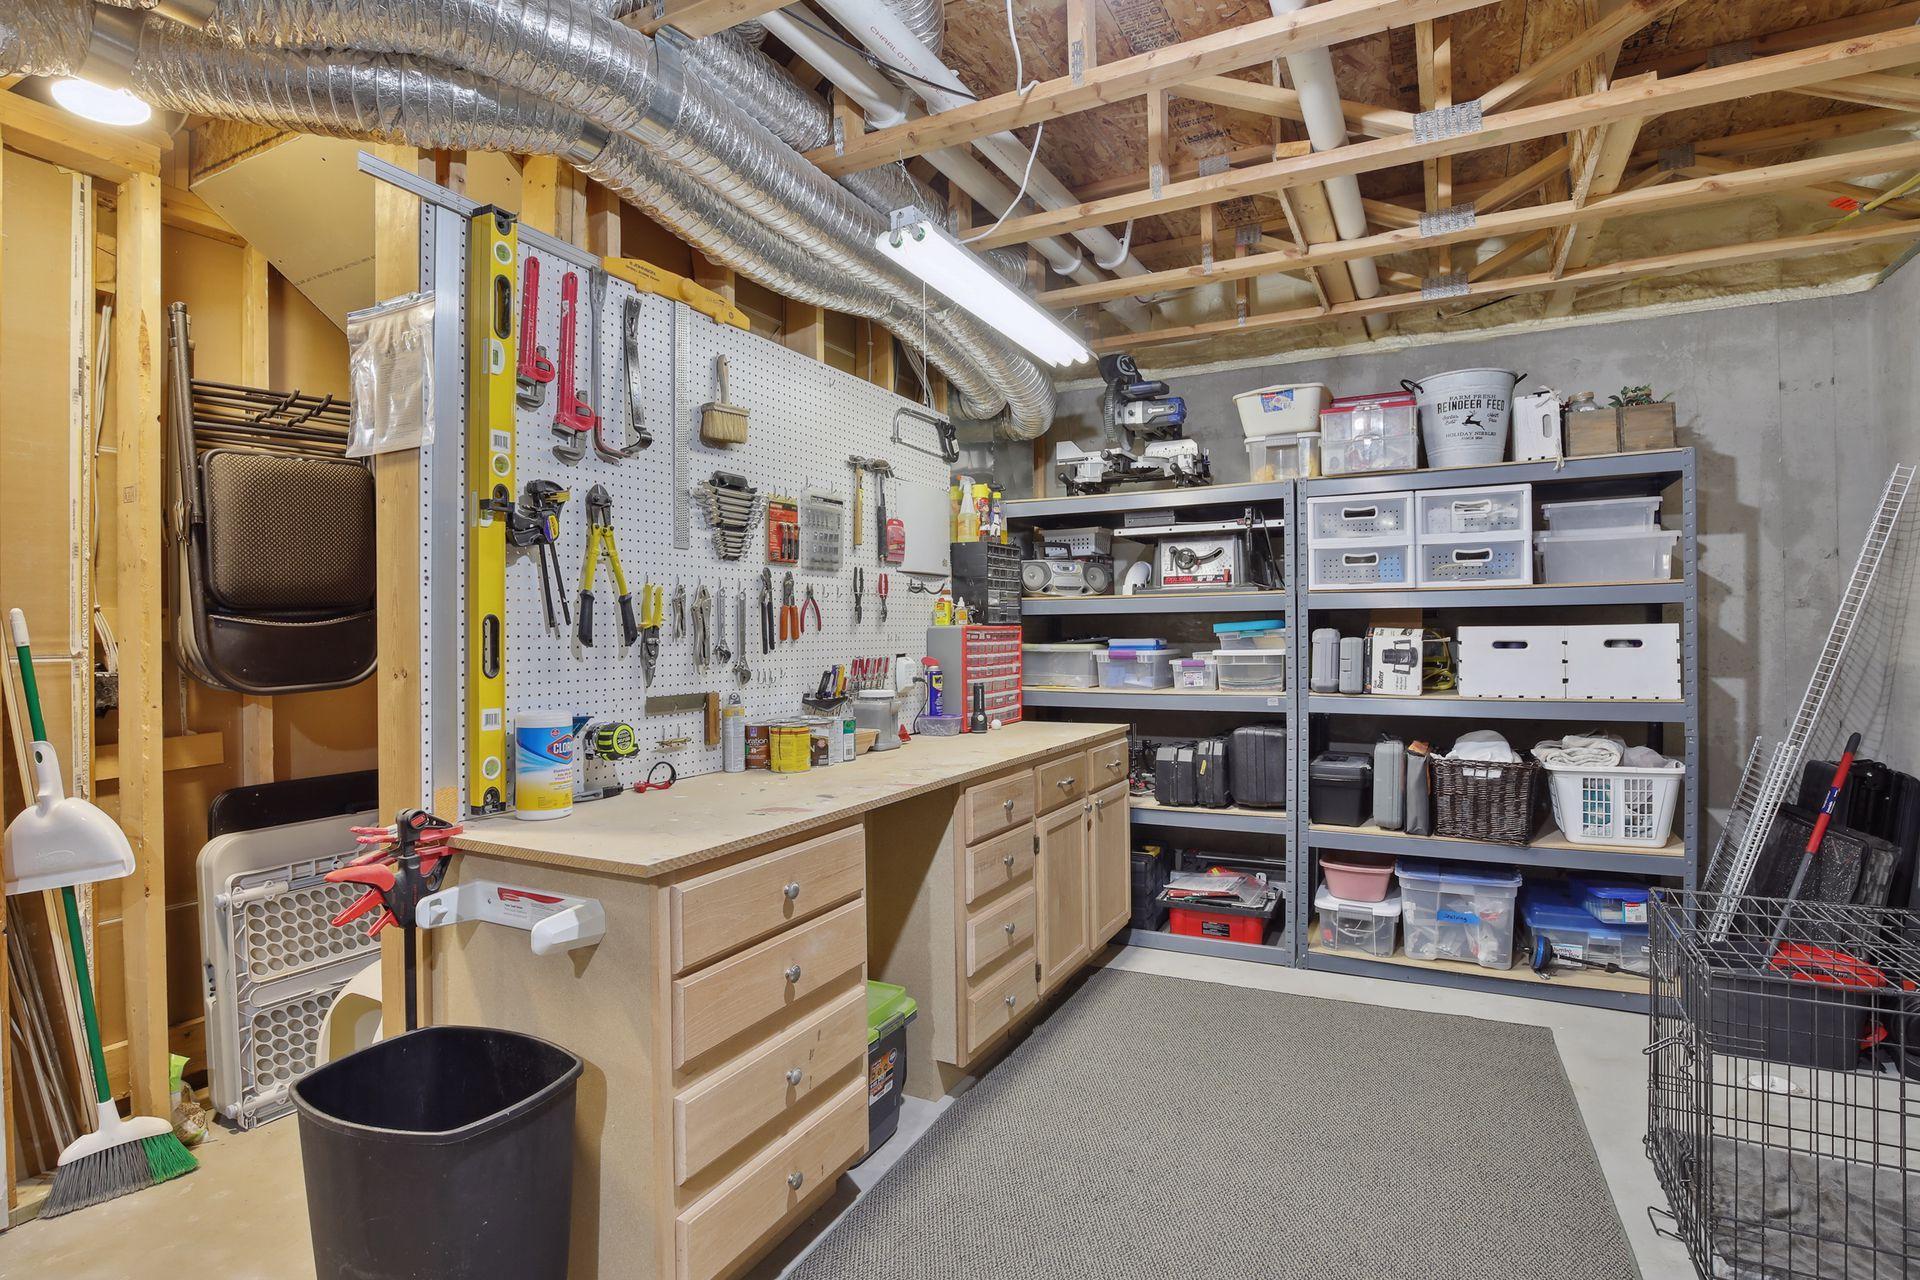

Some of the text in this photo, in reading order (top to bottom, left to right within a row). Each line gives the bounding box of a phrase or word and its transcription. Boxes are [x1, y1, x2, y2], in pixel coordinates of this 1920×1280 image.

[870, 25, 920, 73] CHARLOTTE
[1437, 399, 1505, 414] REINDEER FEED
